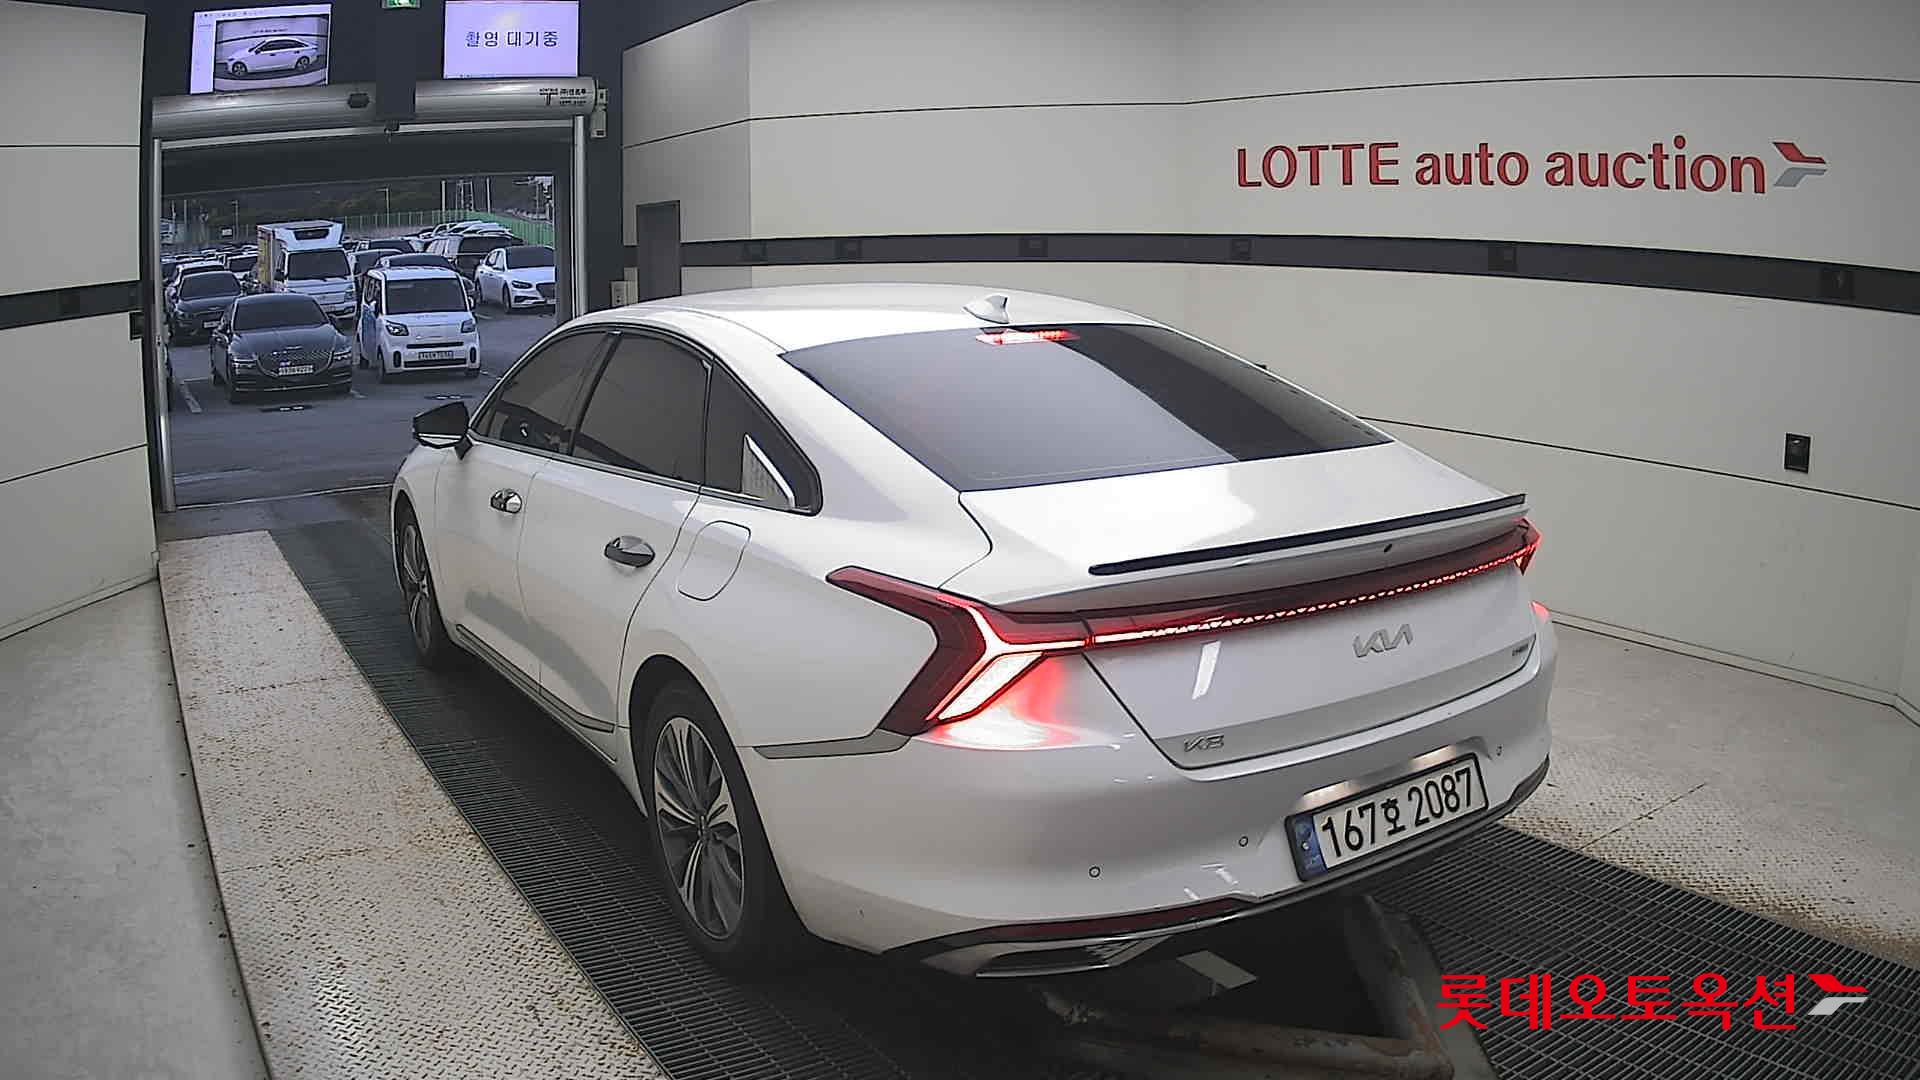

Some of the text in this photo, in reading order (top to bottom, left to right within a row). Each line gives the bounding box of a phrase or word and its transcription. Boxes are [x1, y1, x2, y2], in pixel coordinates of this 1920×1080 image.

[507, 31, 558, 47] 대기중
[1237, 135, 1766, 193] LOTTE auto auction
[1353, 623, 1414, 658] KIA
[1321, 766, 1472, 858] 167호 2087
